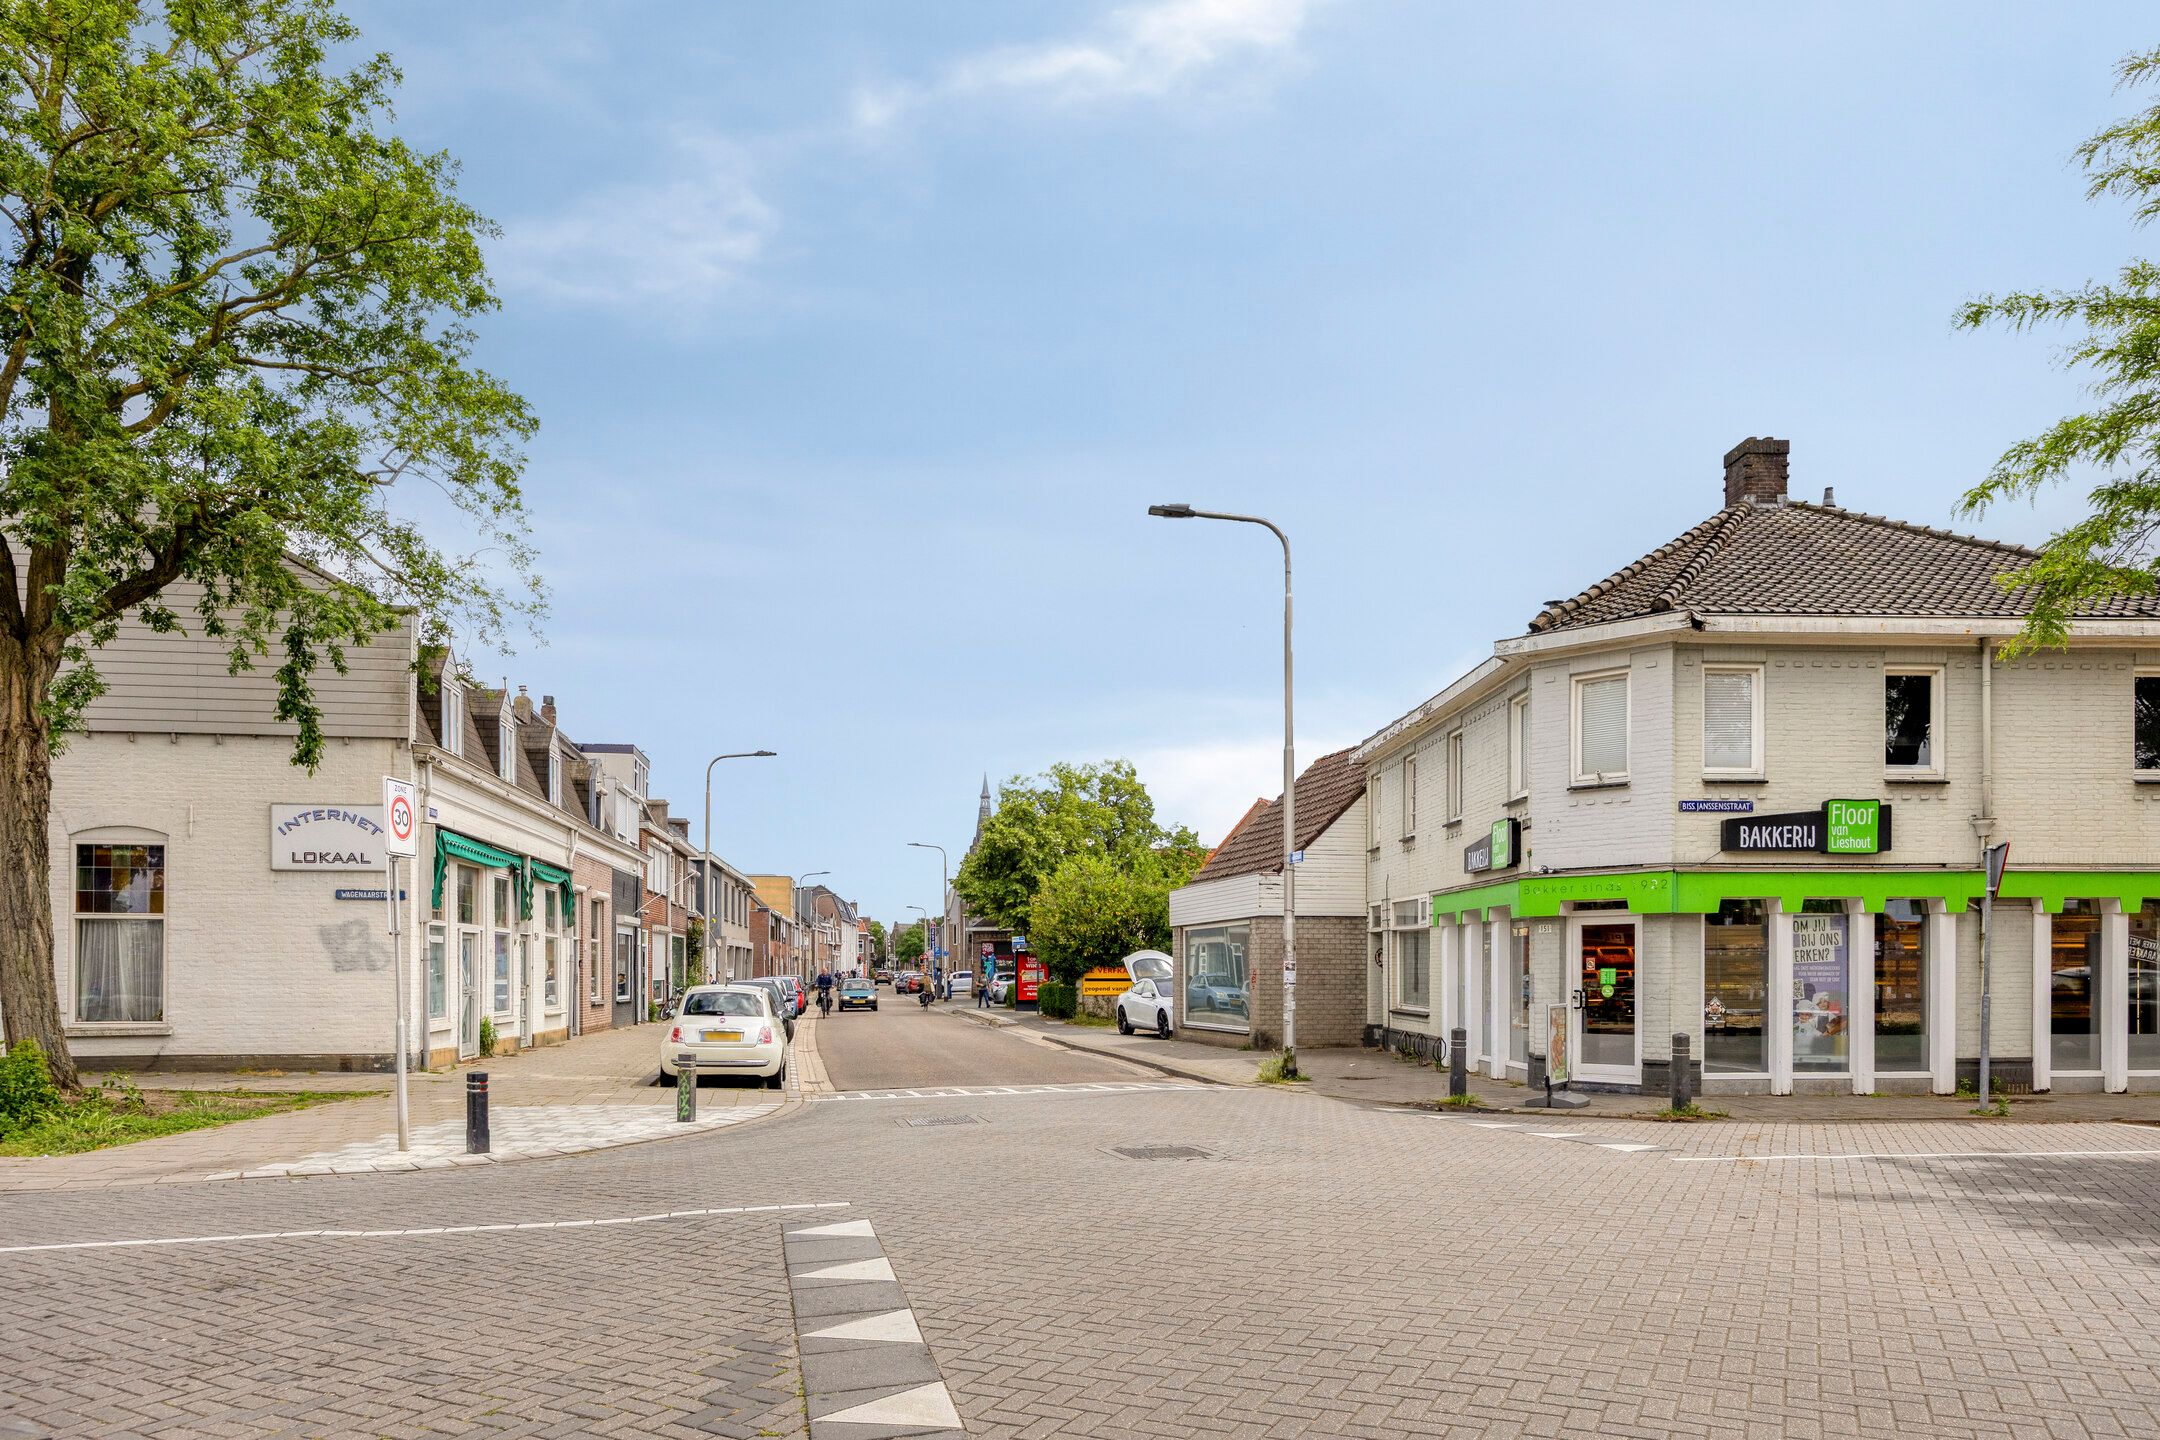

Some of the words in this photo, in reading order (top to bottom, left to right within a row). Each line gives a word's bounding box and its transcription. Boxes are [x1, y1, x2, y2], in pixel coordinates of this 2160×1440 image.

[394, 785, 407, 793] ZONE
[1696, 803, 1751, 811] JANSSENSSTRAAT
[394, 809, 409, 827] 30
[1832, 804, 1875, 826] Floor
[278, 809, 384, 836] INTERNET
[1739, 825, 1816, 848] BAKKERIJ
[1831, 826, 1849, 836] van
[1831, 837, 1872, 849] Lieshout
[291, 852, 372, 864] LOKAAL
[340, 891, 390, 899] WAGENAARSTR
[1523, 884, 1574, 895] Bakker
[1793, 920, 1809, 933] OM
[1812, 919, 1826, 932] JIJ
[1801, 934, 1816, 947] BIJ
[1819, 932, 1840, 946] ONS
[1793, 948, 1830, 962] ERKEN?
